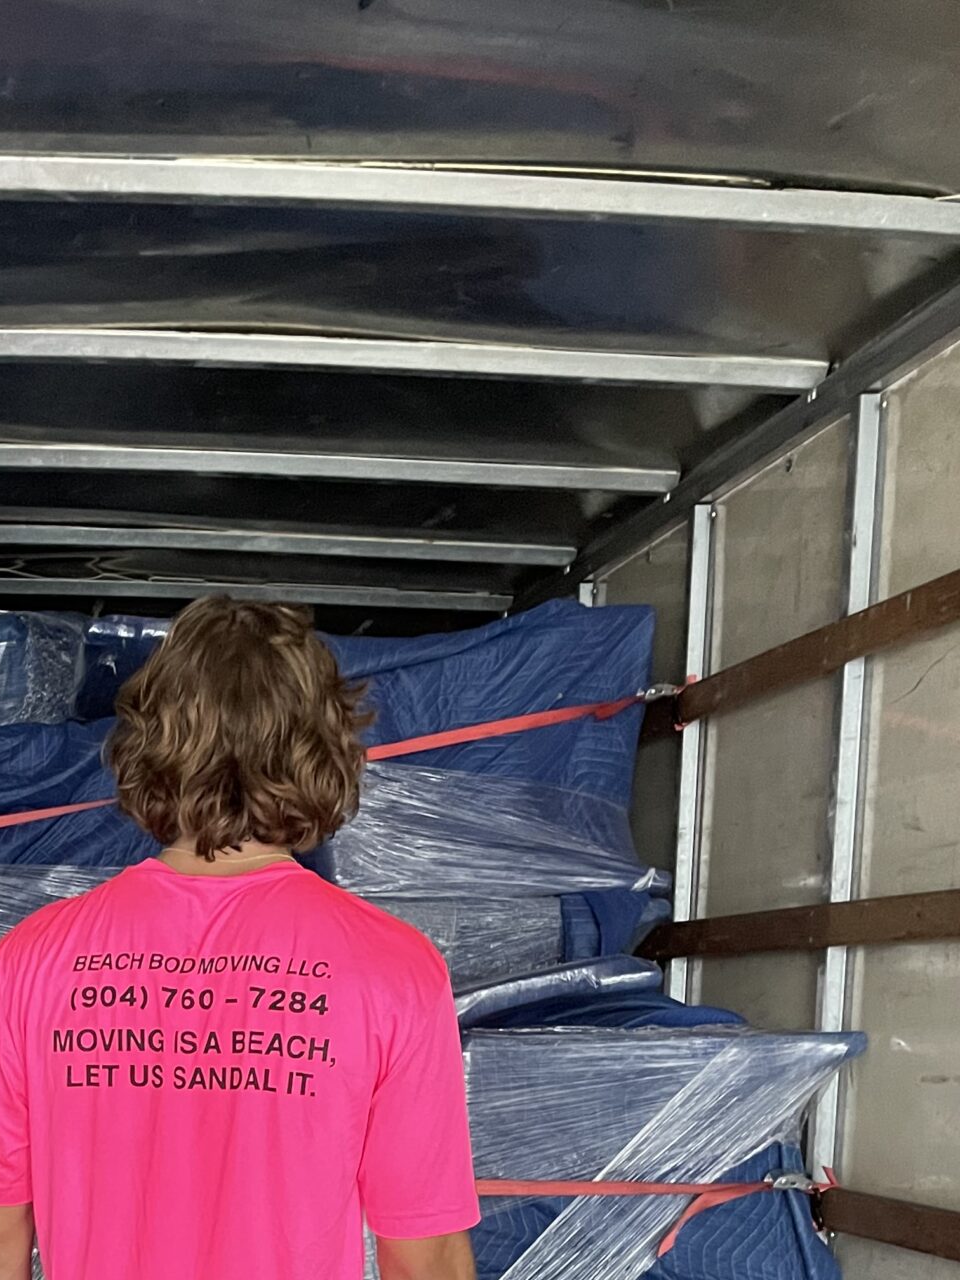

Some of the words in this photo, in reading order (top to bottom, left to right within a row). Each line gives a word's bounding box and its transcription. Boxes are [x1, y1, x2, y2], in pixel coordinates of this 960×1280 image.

[73, 953, 144, 972] BEACH
[148, 953, 196, 974] BOD
[197, 955, 280, 975] MOVING
[286, 957, 333, 979] LLC.
[70, 985, 148, 1011] (904)
[161, 986, 214, 1010] 760
[248, 986, 329, 1016] 7284
[52, 1028, 165, 1053] MOVING
[173, 1030, 198, 1054] IS
[203, 1031, 222, 1054] A
[231, 1030, 337, 1068] BEACH,
[66, 1064, 119, 1088] LET
[129, 1064, 164, 1088] US
[173, 1066, 277, 1093] SANDAL
[286, 1071, 316, 1097] IT.
